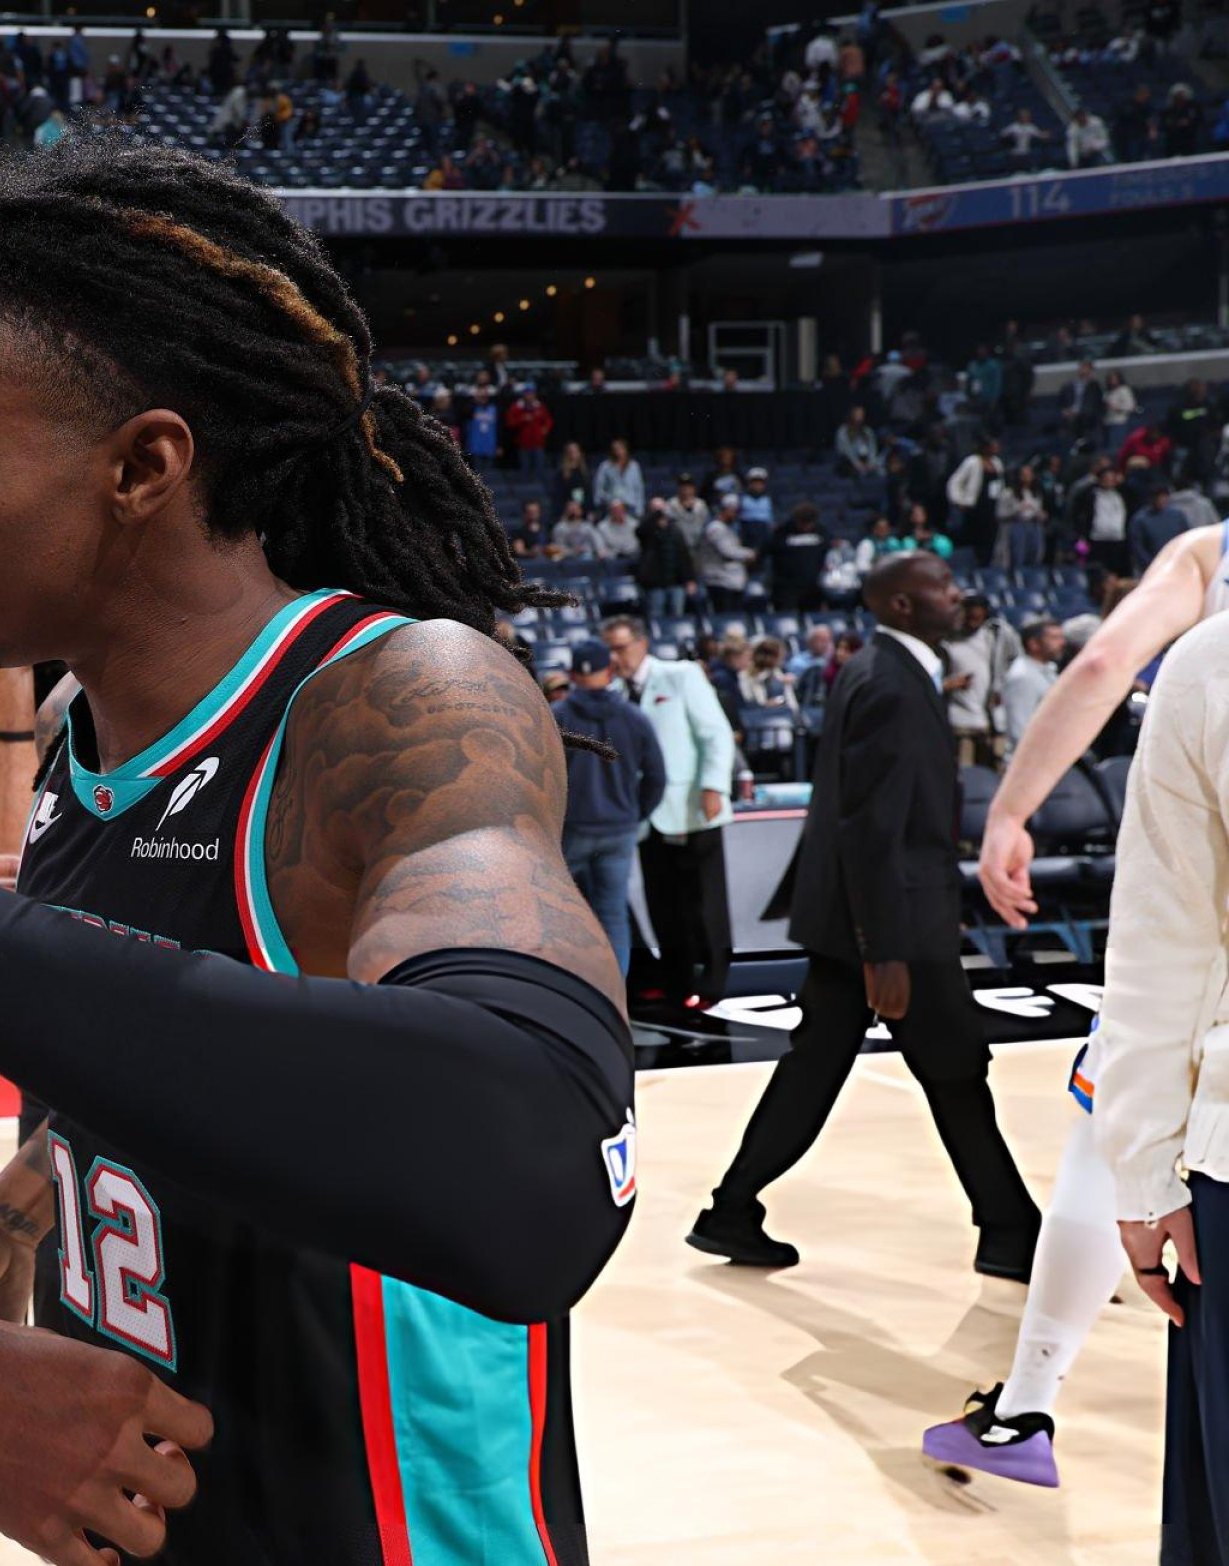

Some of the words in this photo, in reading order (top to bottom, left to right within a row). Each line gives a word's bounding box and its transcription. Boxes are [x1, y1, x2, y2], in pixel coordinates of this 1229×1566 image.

[284, 198, 392, 234] PHIS
[404, 198, 608, 235] GRIZZLIES
[1010, 181, 1072, 220] 114
[130, 836, 221, 861] Robinhood
[48, 1129, 178, 1373] 12
